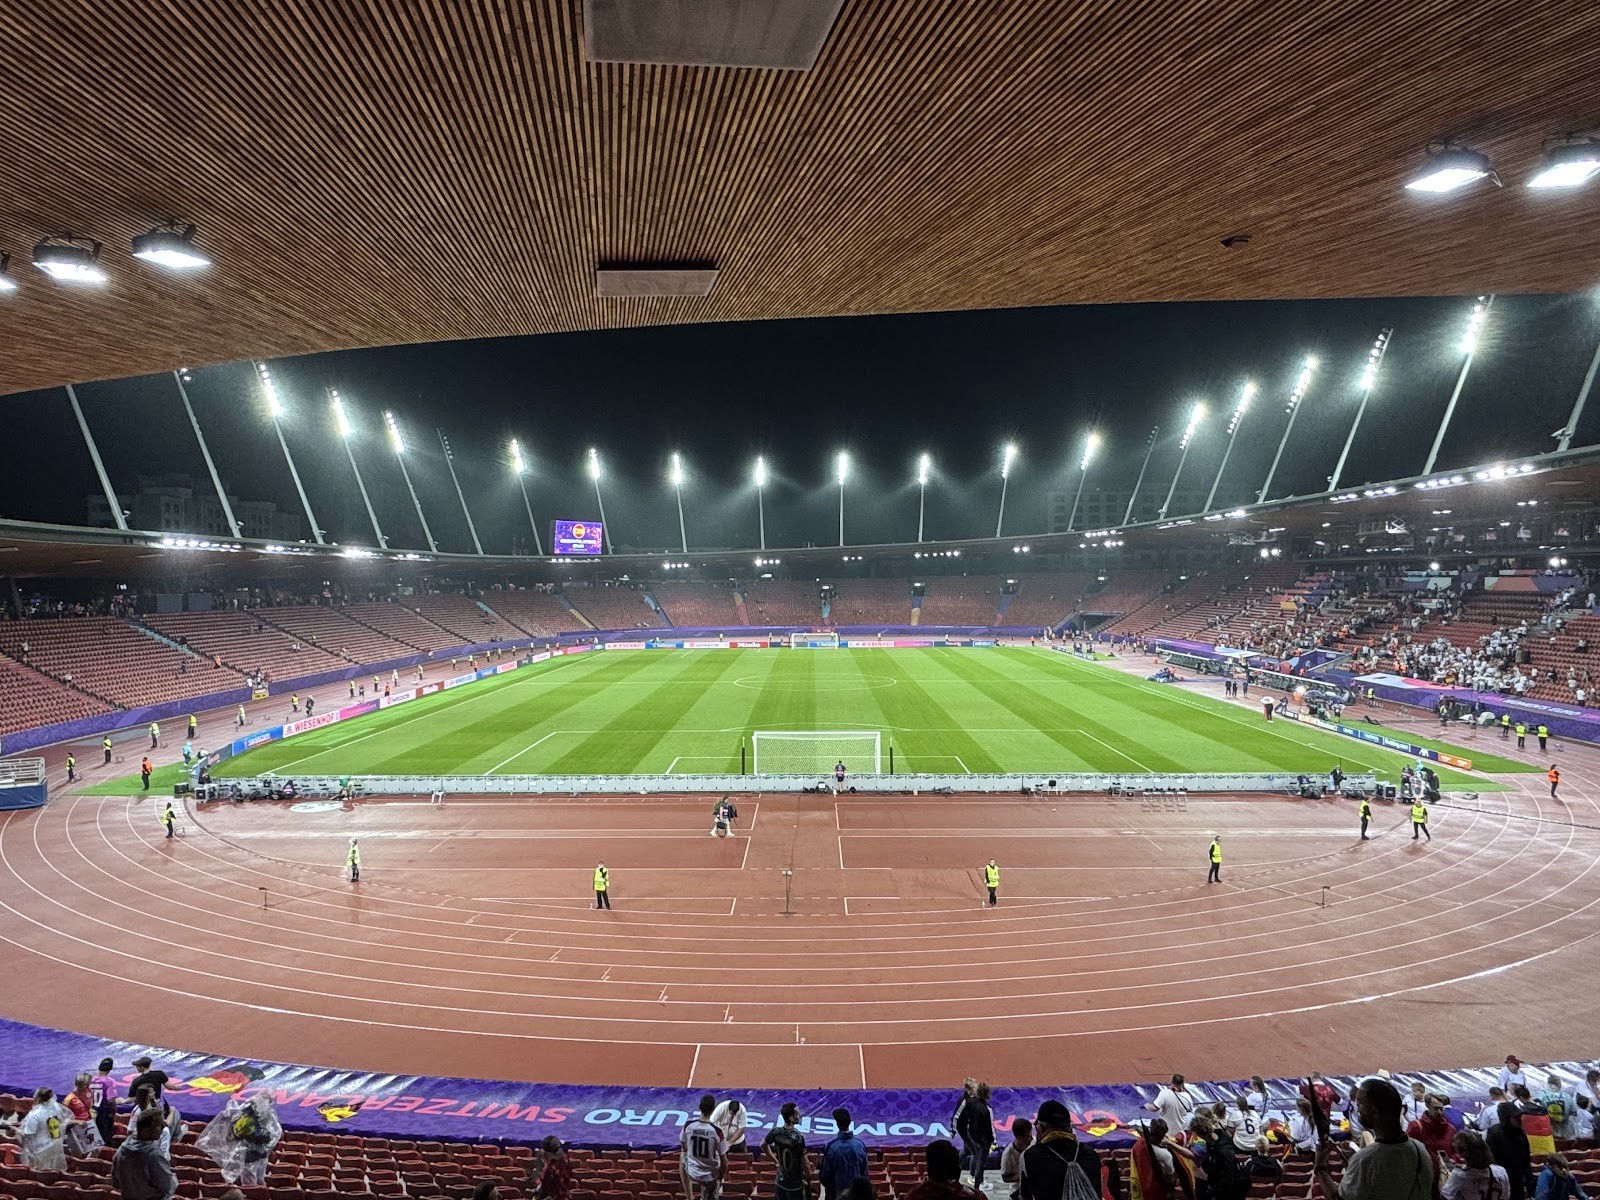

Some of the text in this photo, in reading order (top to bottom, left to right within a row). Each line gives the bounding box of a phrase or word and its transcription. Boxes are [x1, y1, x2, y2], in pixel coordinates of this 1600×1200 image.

[295, 713, 335, 732] WIESENHOF
[1245, 1128, 1256, 1145] 6
[691, 1136, 709, 1159] 10
